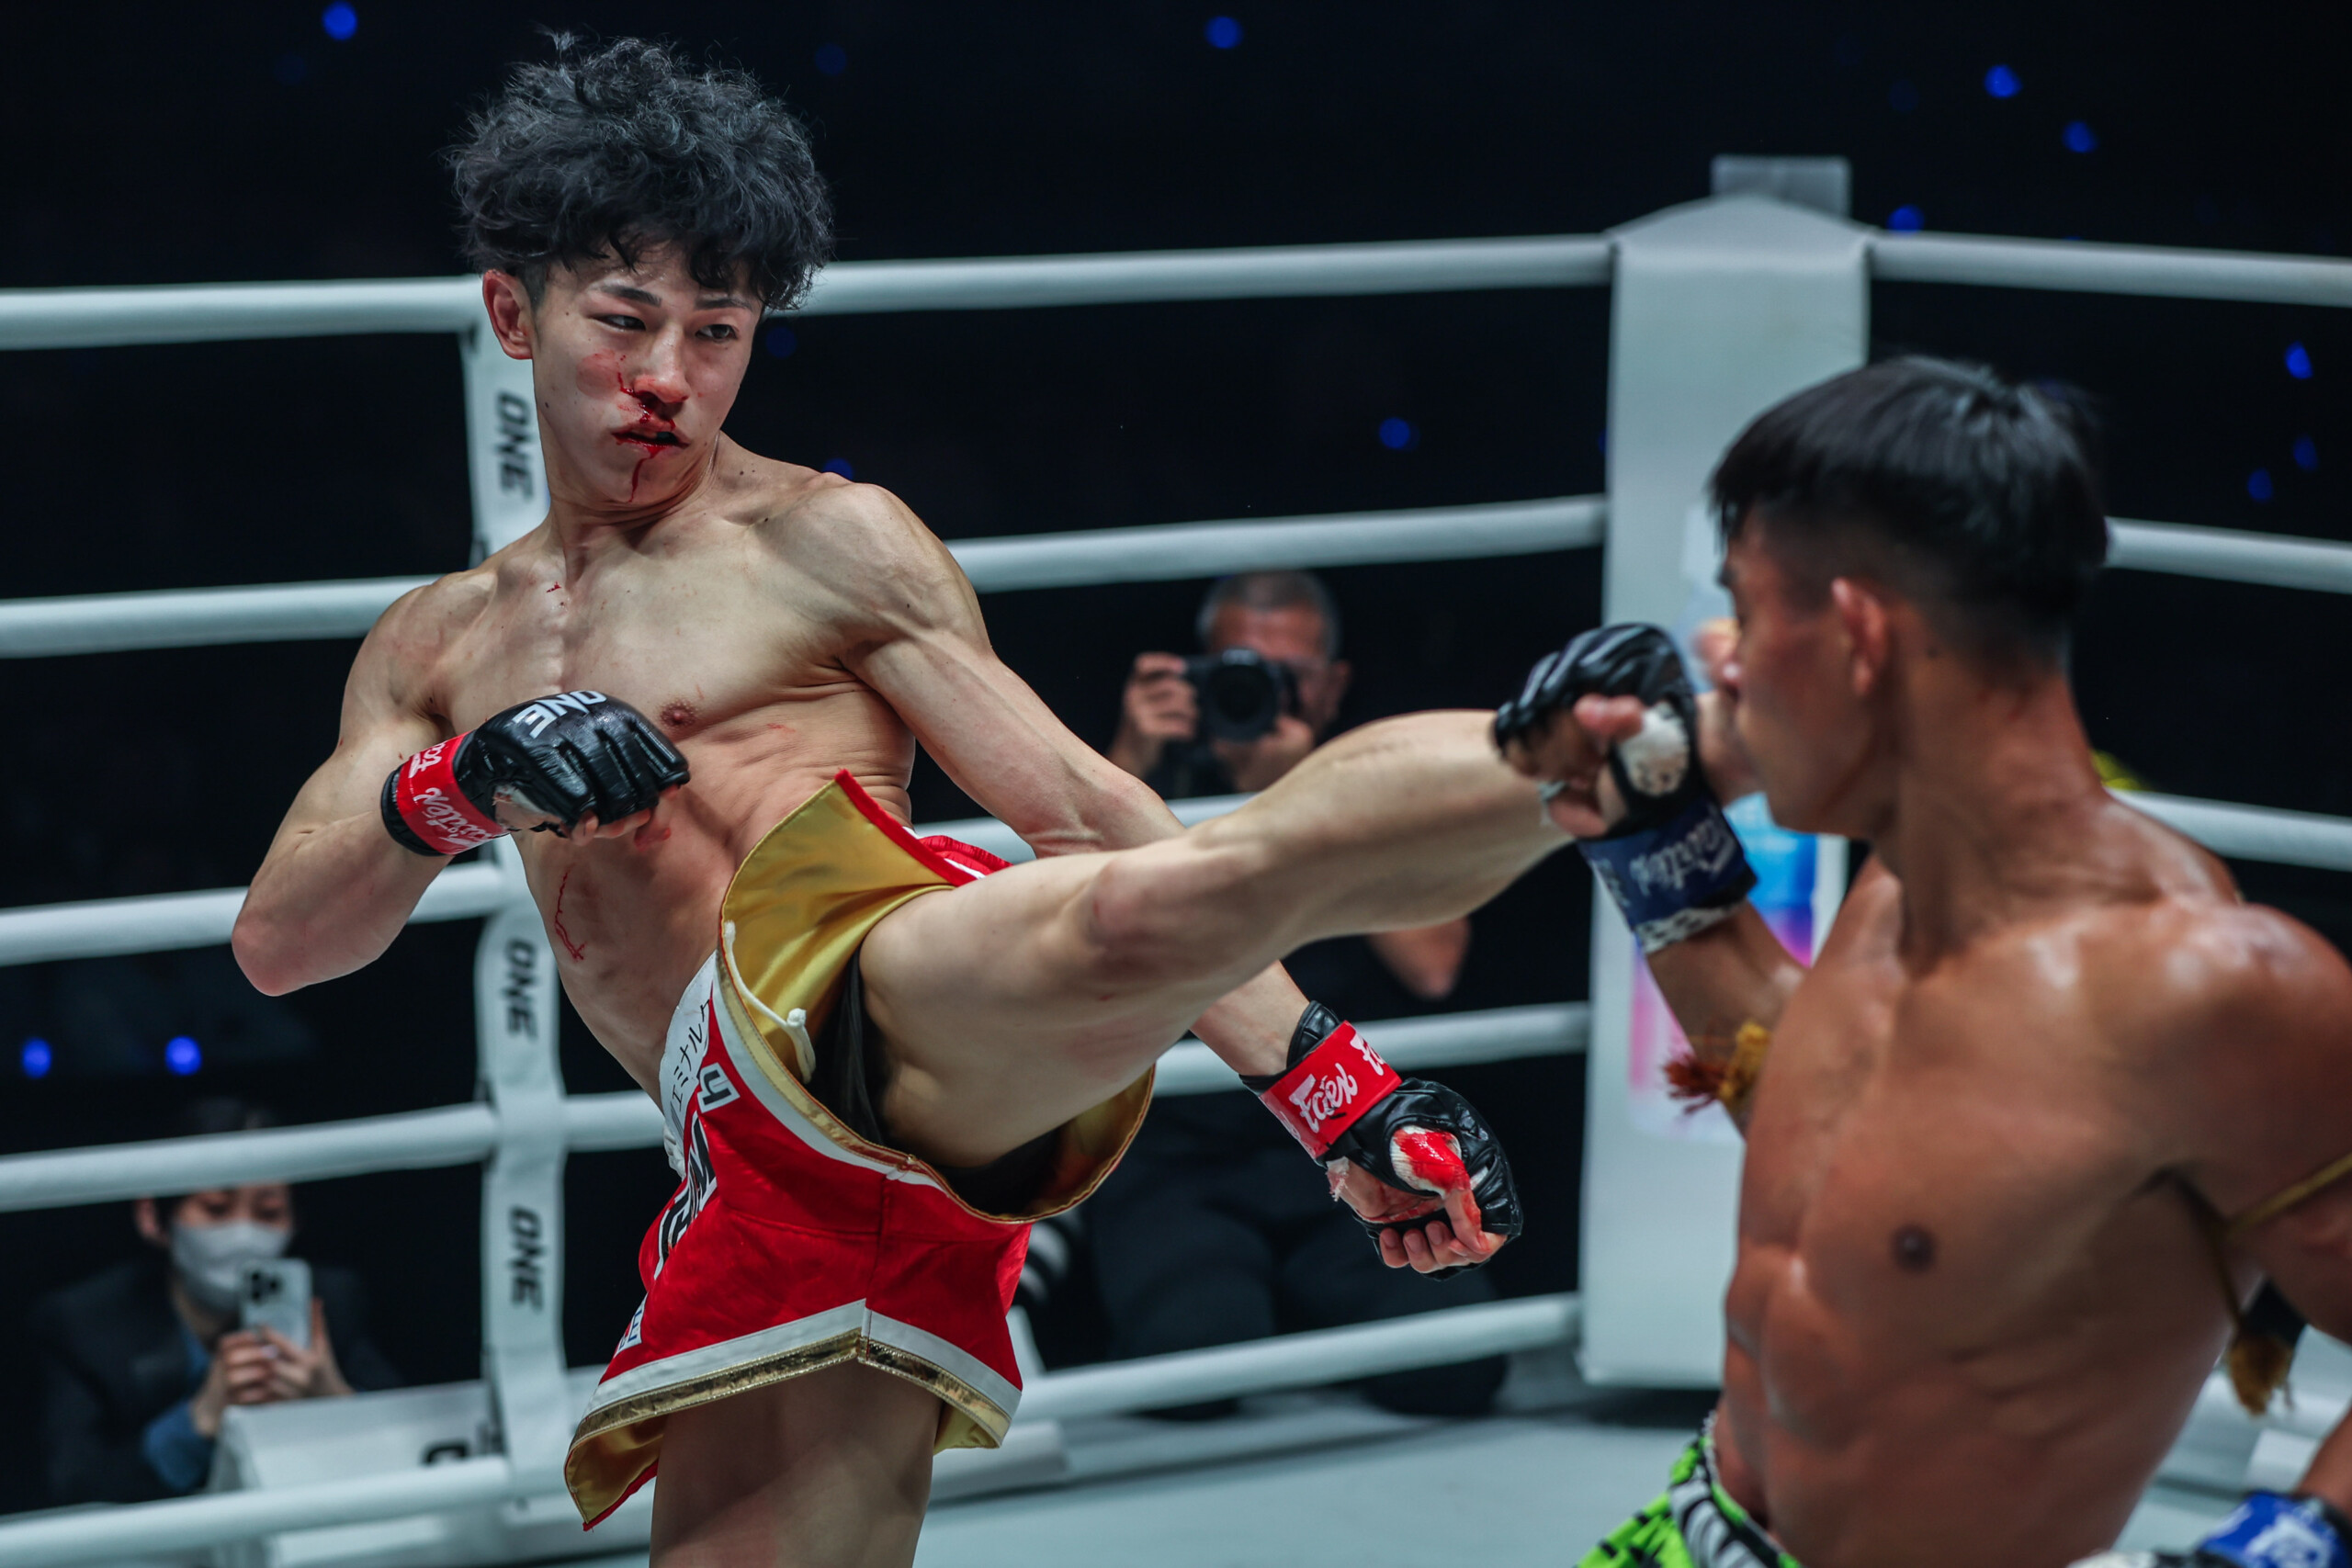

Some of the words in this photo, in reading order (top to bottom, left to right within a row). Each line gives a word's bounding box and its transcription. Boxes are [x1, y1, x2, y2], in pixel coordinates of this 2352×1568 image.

[495, 390, 533, 502] ONE
[512, 690, 607, 739] ONE
[503, 939, 539, 1041] ONE
[508, 1207, 545, 1314] ONE
